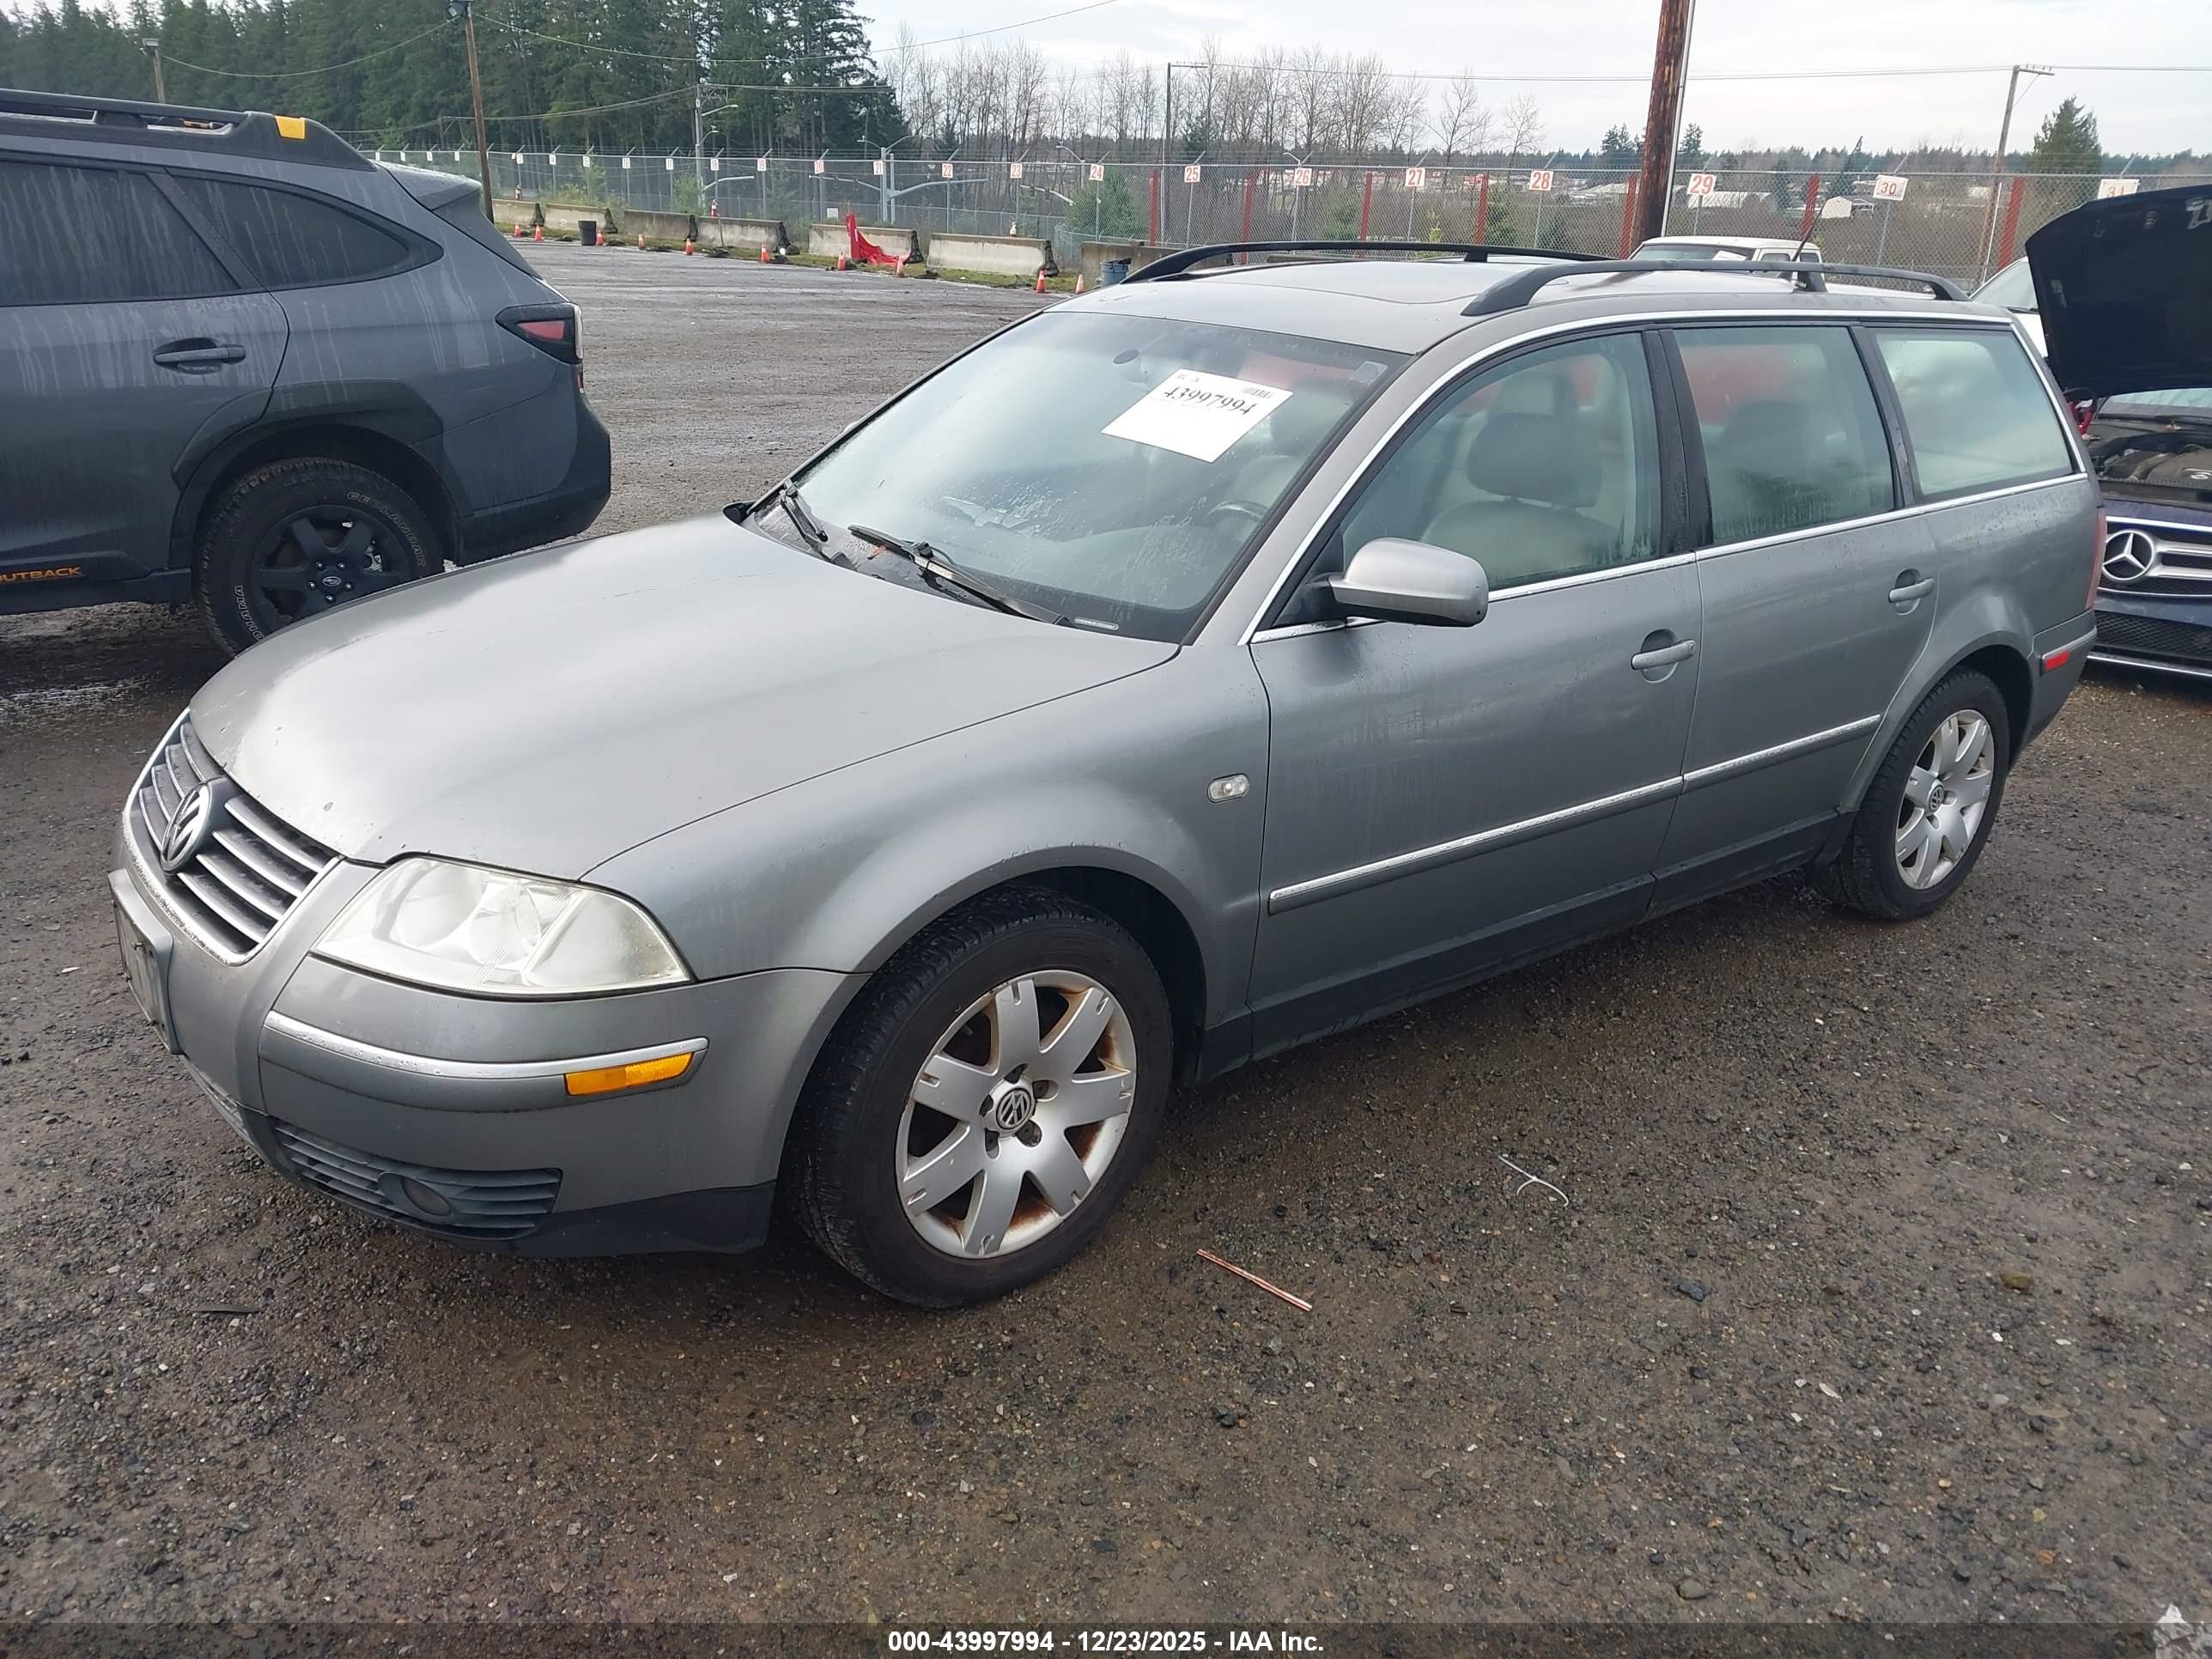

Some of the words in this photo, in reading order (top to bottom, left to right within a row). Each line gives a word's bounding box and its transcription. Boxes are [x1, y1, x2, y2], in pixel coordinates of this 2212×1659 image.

[816, 161, 823, 173] 20
[875, 162, 883, 174] 21
[944, 164, 952, 177] 22
[1012, 164, 1021, 177] 23
[1091, 165, 1103, 179] 24
[1186, 167, 1199, 181] 25
[1295, 169, 1310, 185] 26
[1407, 168, 1423, 185] 27
[1531, 173, 1551, 190] 28
[1692, 174, 1714, 194] 29
[1881, 182, 1897, 195] 30
[1164, 386, 1257, 415] 43997994
[346, 491, 426, 568] GEOLANDAR
[0, 567, 82, 582] UTBACK
